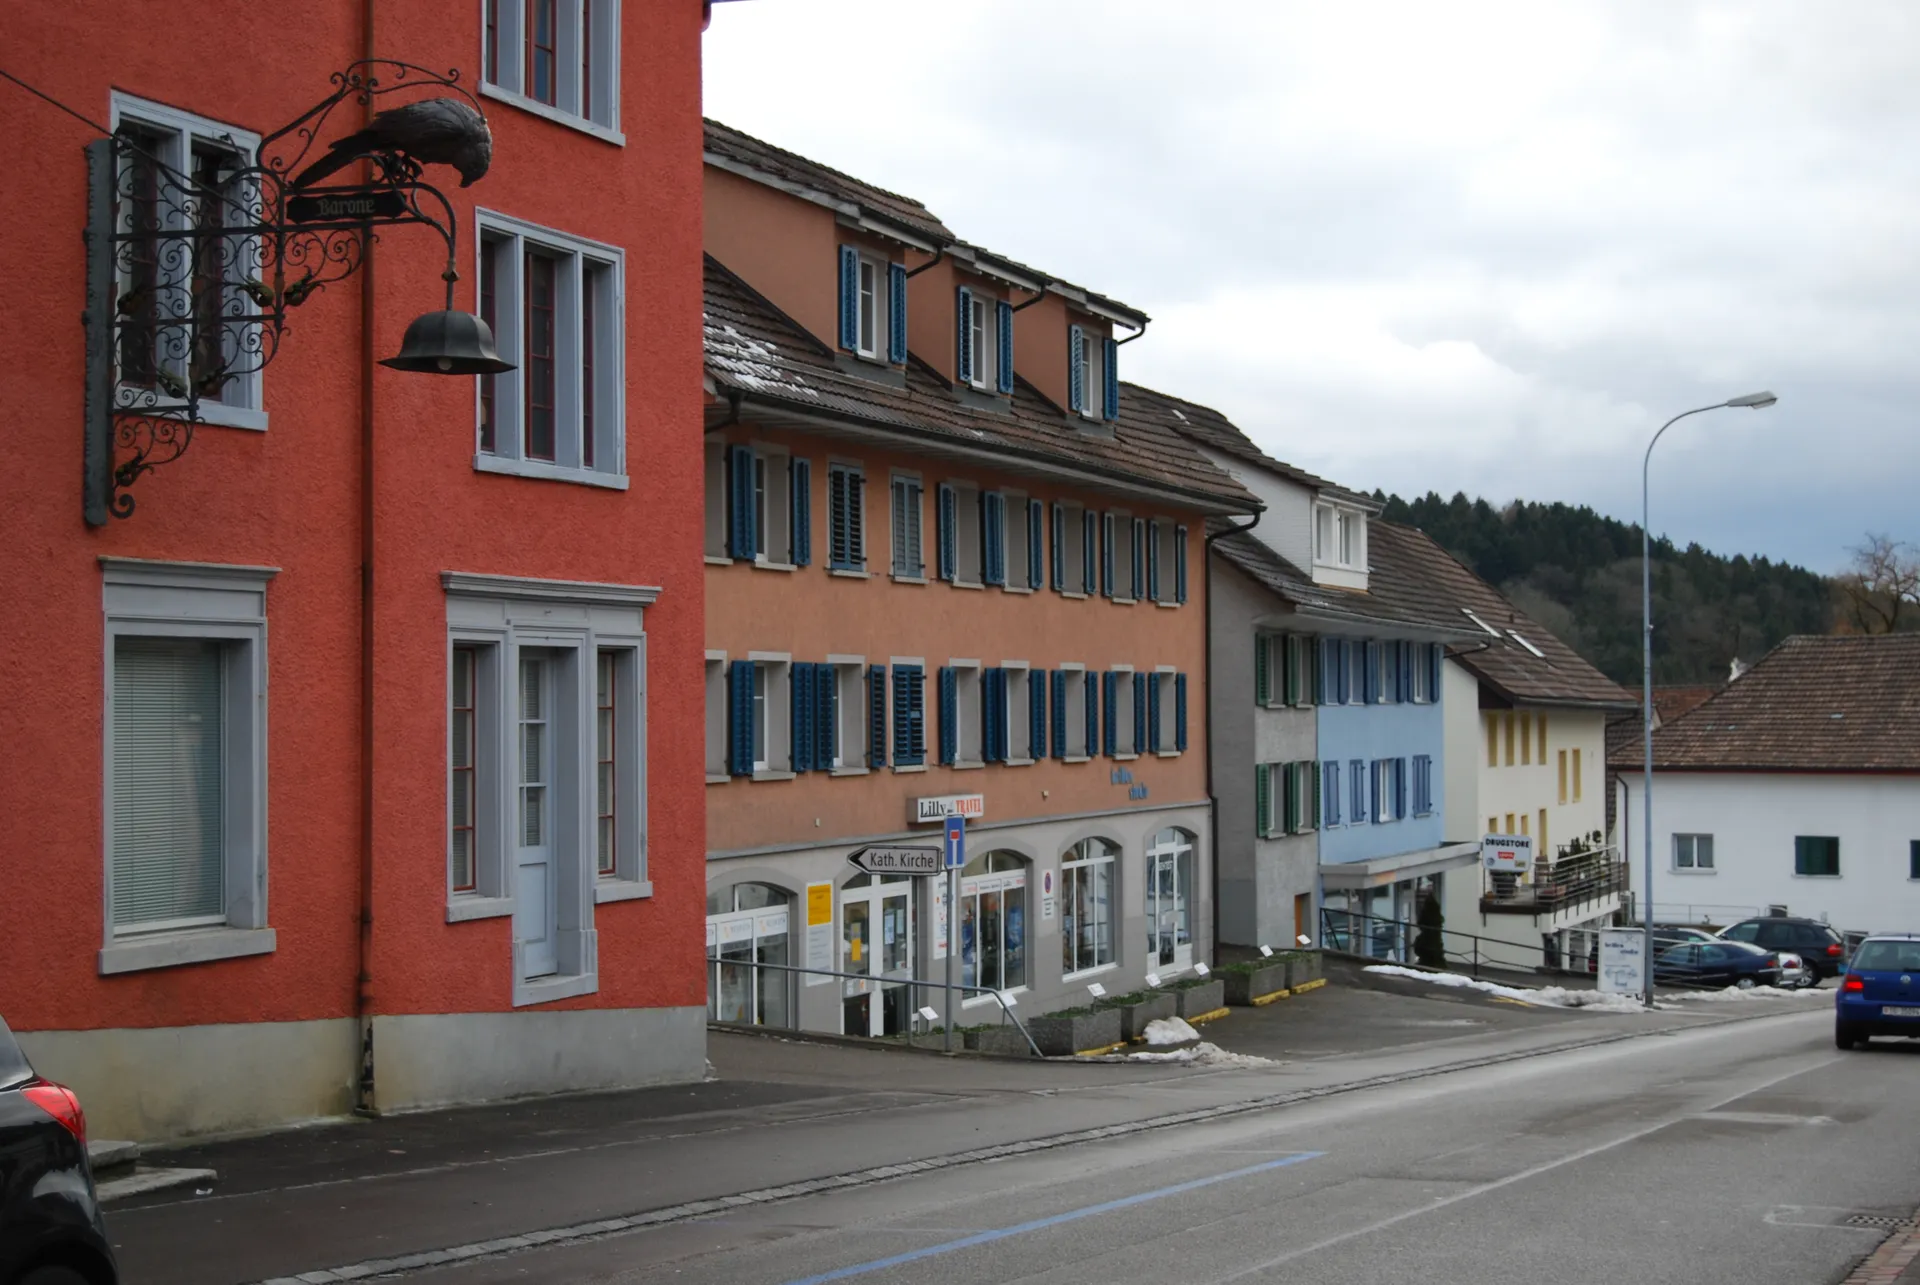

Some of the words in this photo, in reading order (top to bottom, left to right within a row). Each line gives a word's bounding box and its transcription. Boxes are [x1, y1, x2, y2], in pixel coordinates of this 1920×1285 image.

[315, 198, 376, 217] Barone
[920, 800, 947, 818] Lilly
[955, 798, 981, 814] TRAVEL
[1485, 838, 1530, 848] DRUGSTORE
[870, 852, 898, 867] Kath.
[900, 853, 934, 868] Kirche
